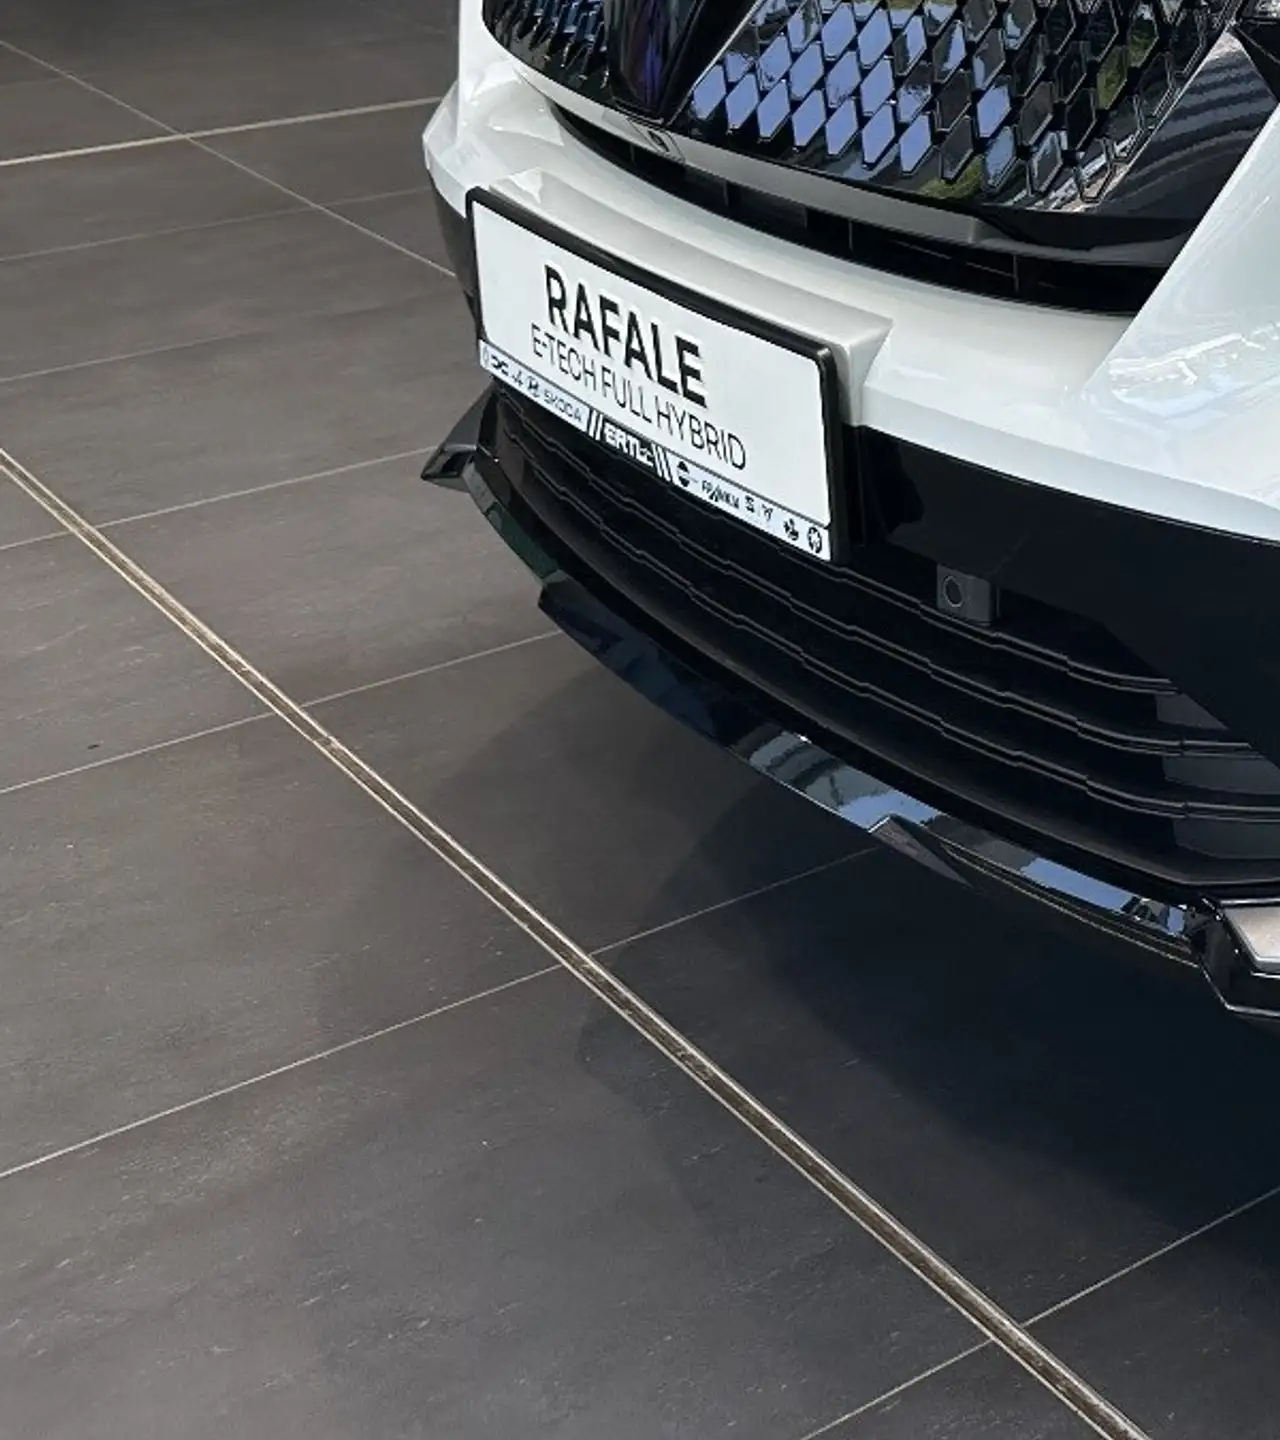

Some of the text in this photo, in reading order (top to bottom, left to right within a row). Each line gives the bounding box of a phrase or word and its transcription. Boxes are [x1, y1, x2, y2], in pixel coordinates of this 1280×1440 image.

[531, 322, 747, 470] E-TECH FULL HYBRID
[545, 264, 708, 408] RAFALE
